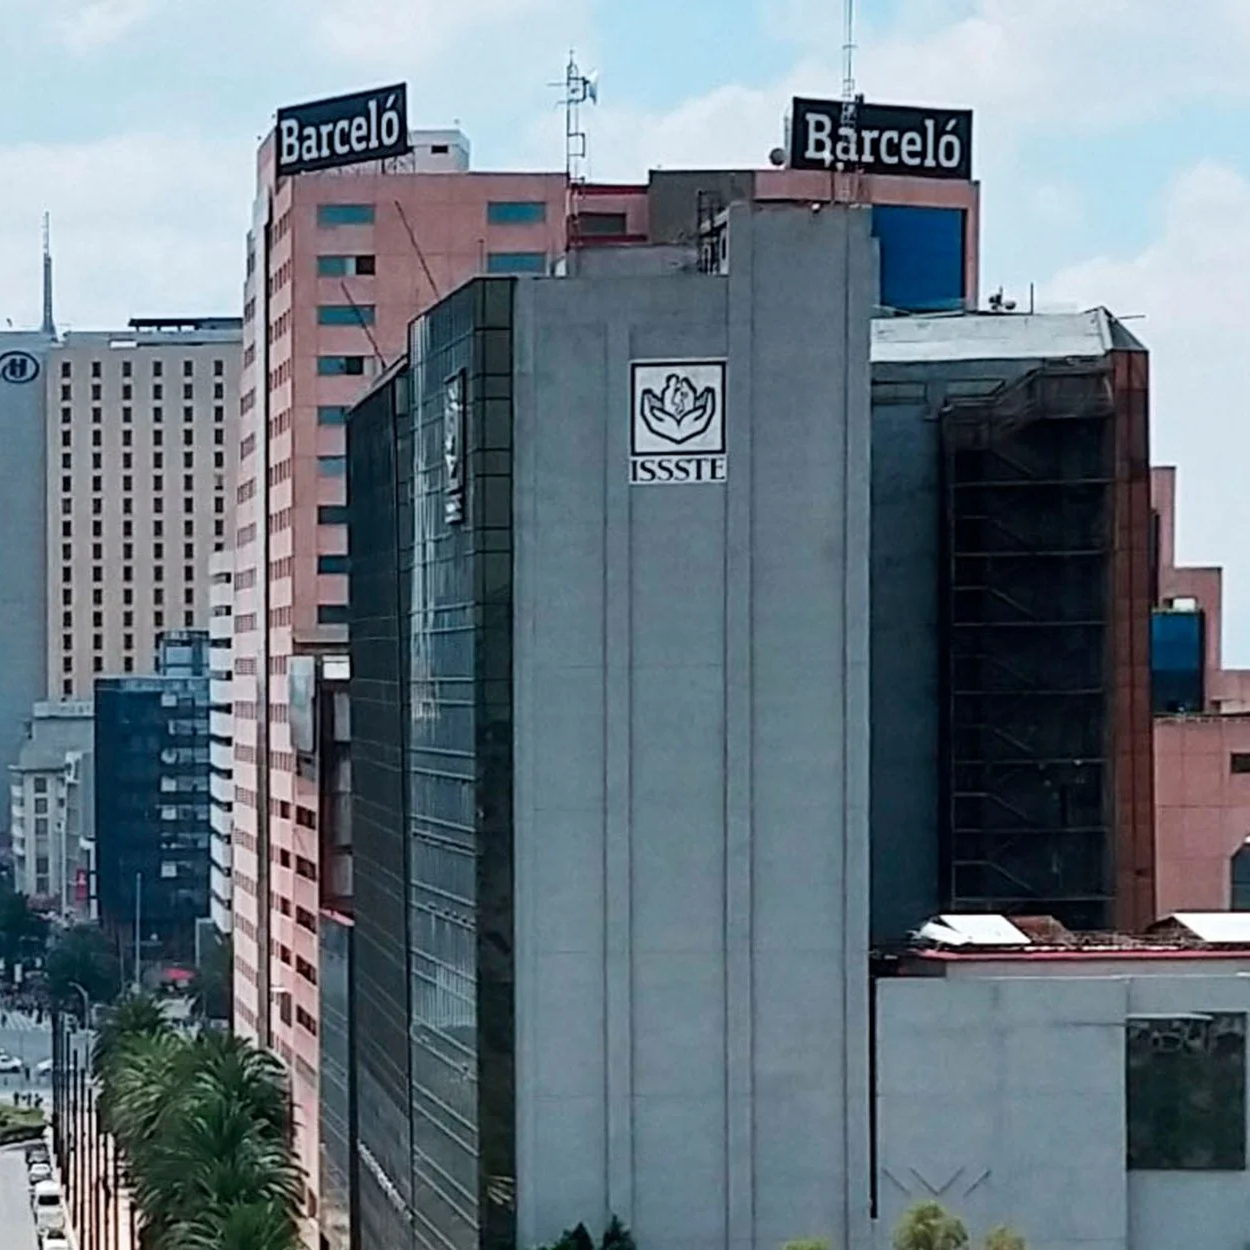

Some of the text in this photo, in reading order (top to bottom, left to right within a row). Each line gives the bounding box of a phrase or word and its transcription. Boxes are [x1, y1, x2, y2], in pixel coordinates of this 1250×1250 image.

[280, 94, 399, 165] Barceló
[804, 112, 961, 168] Barceló
[632, 457, 726, 481] ISSSTE
